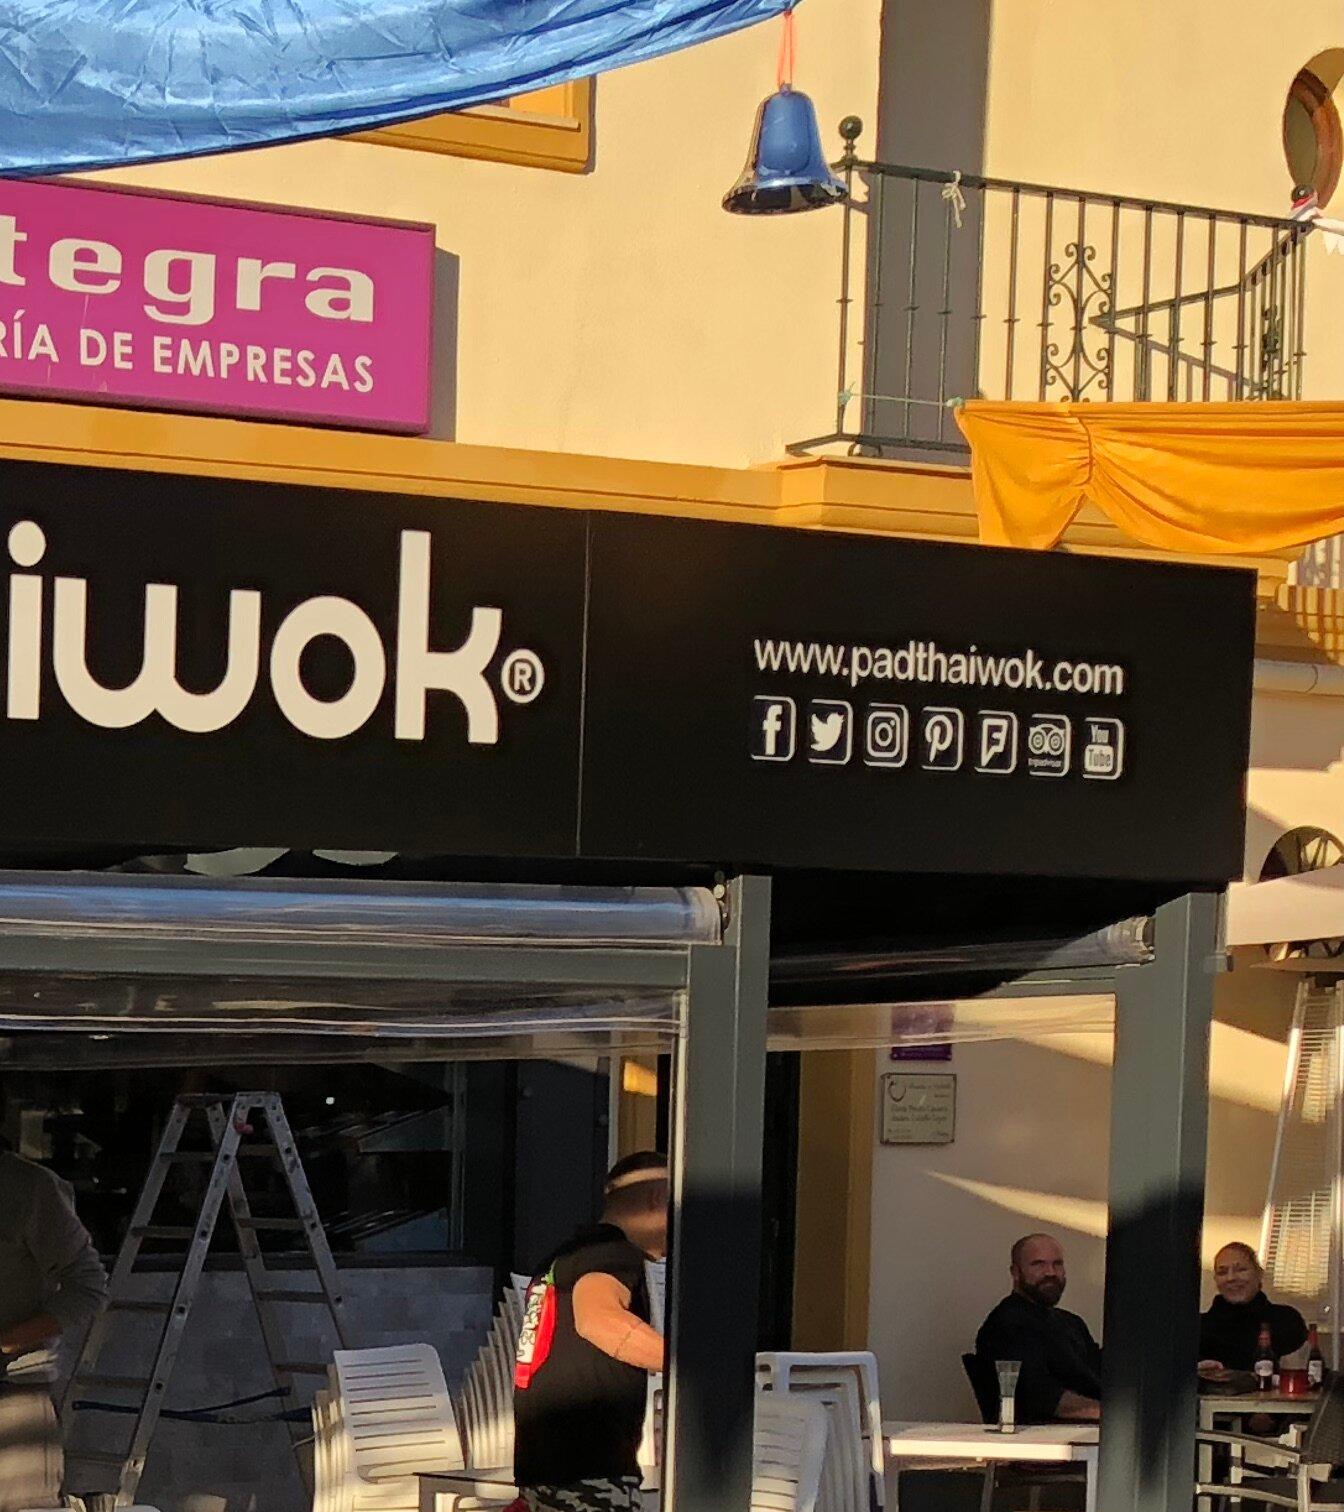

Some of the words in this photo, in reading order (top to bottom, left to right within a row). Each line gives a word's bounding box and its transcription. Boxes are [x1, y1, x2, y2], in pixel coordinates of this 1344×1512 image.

[79, 327, 136, 372] DE
[152, 335, 376, 394] EMPRESAS
[754, 639, 1124, 695] www.padthaiwok.com
